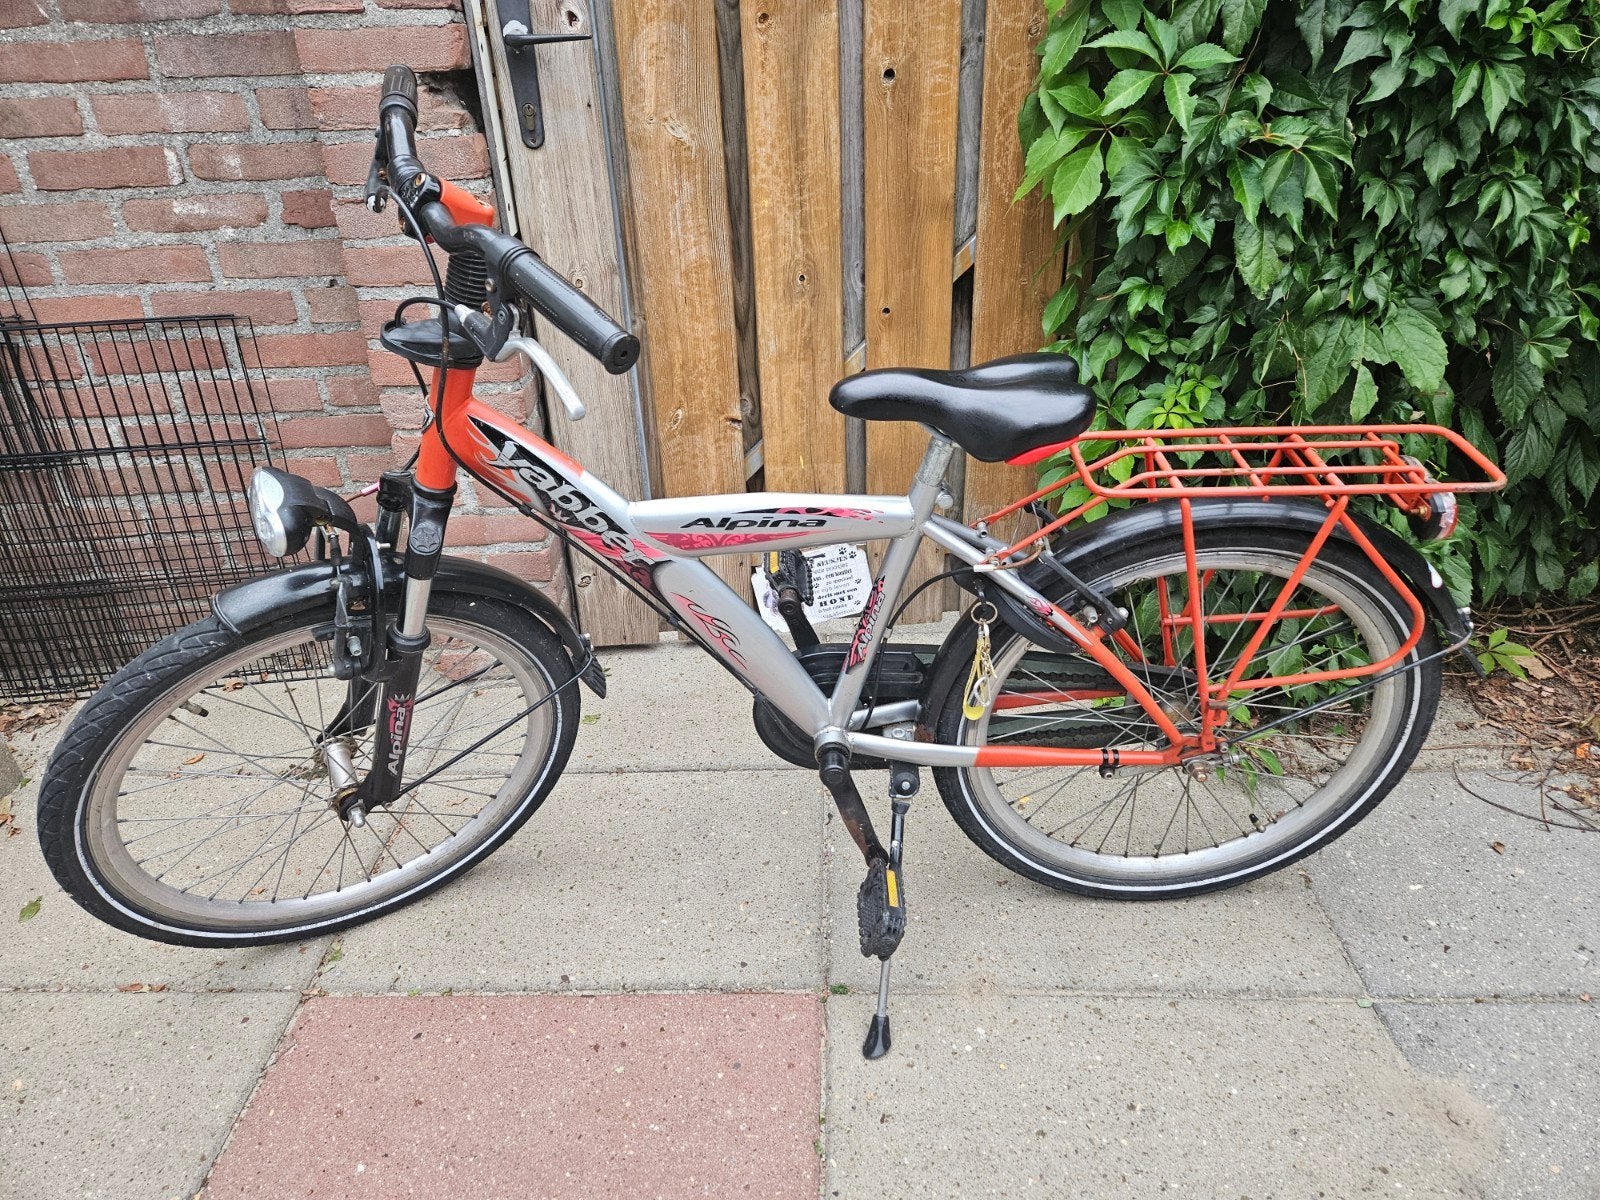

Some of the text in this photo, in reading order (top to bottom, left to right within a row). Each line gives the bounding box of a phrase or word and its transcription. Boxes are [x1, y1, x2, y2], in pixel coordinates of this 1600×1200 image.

[680, 516, 827, 531] Alpina
[819, 594, 854, 607] HOND
[387, 706, 406, 776] Alpina
